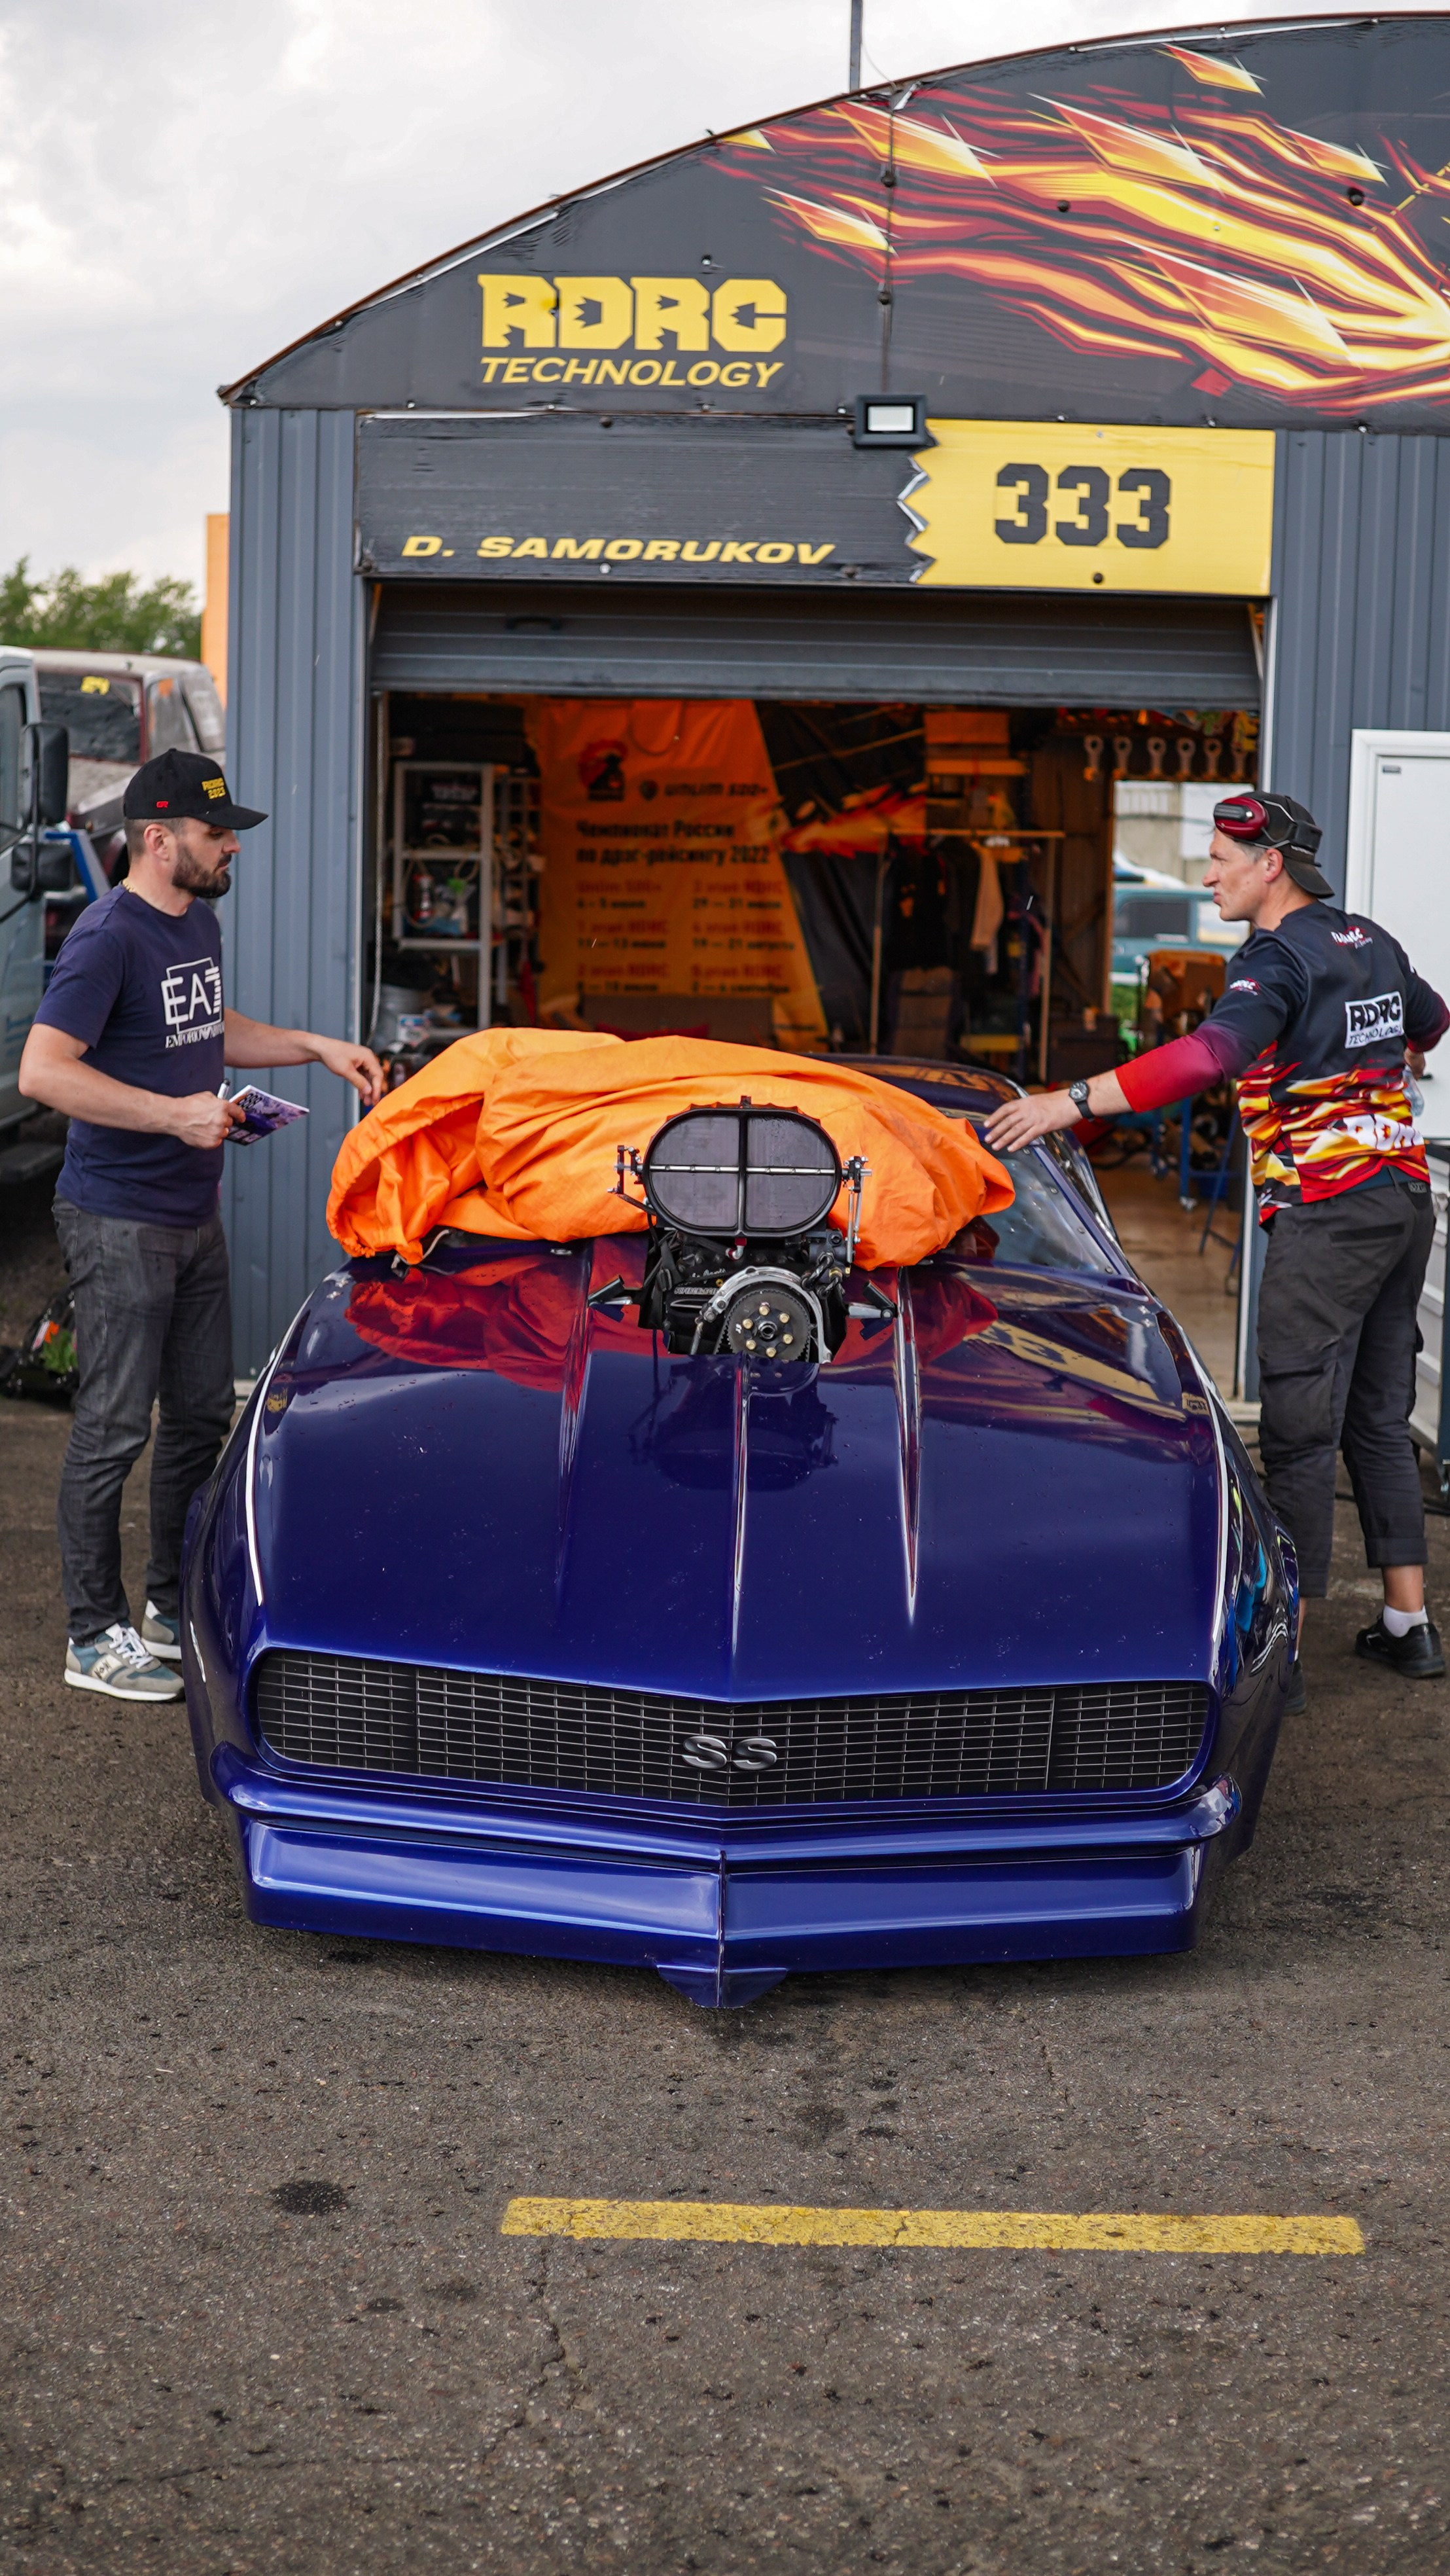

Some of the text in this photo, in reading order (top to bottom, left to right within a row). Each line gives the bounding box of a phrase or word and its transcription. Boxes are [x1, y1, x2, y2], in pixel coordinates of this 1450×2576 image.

[477, 274, 787, 352] RDRC
[479, 356, 785, 388] TECHNOLOGY
[994, 463, 1171, 550] 333
[401, 535, 836, 565] D. SAMORUKOV
[673, 819, 734, 838] России
[161, 965, 221, 1026] EA7
[681, 1736, 777, 1771] SS
